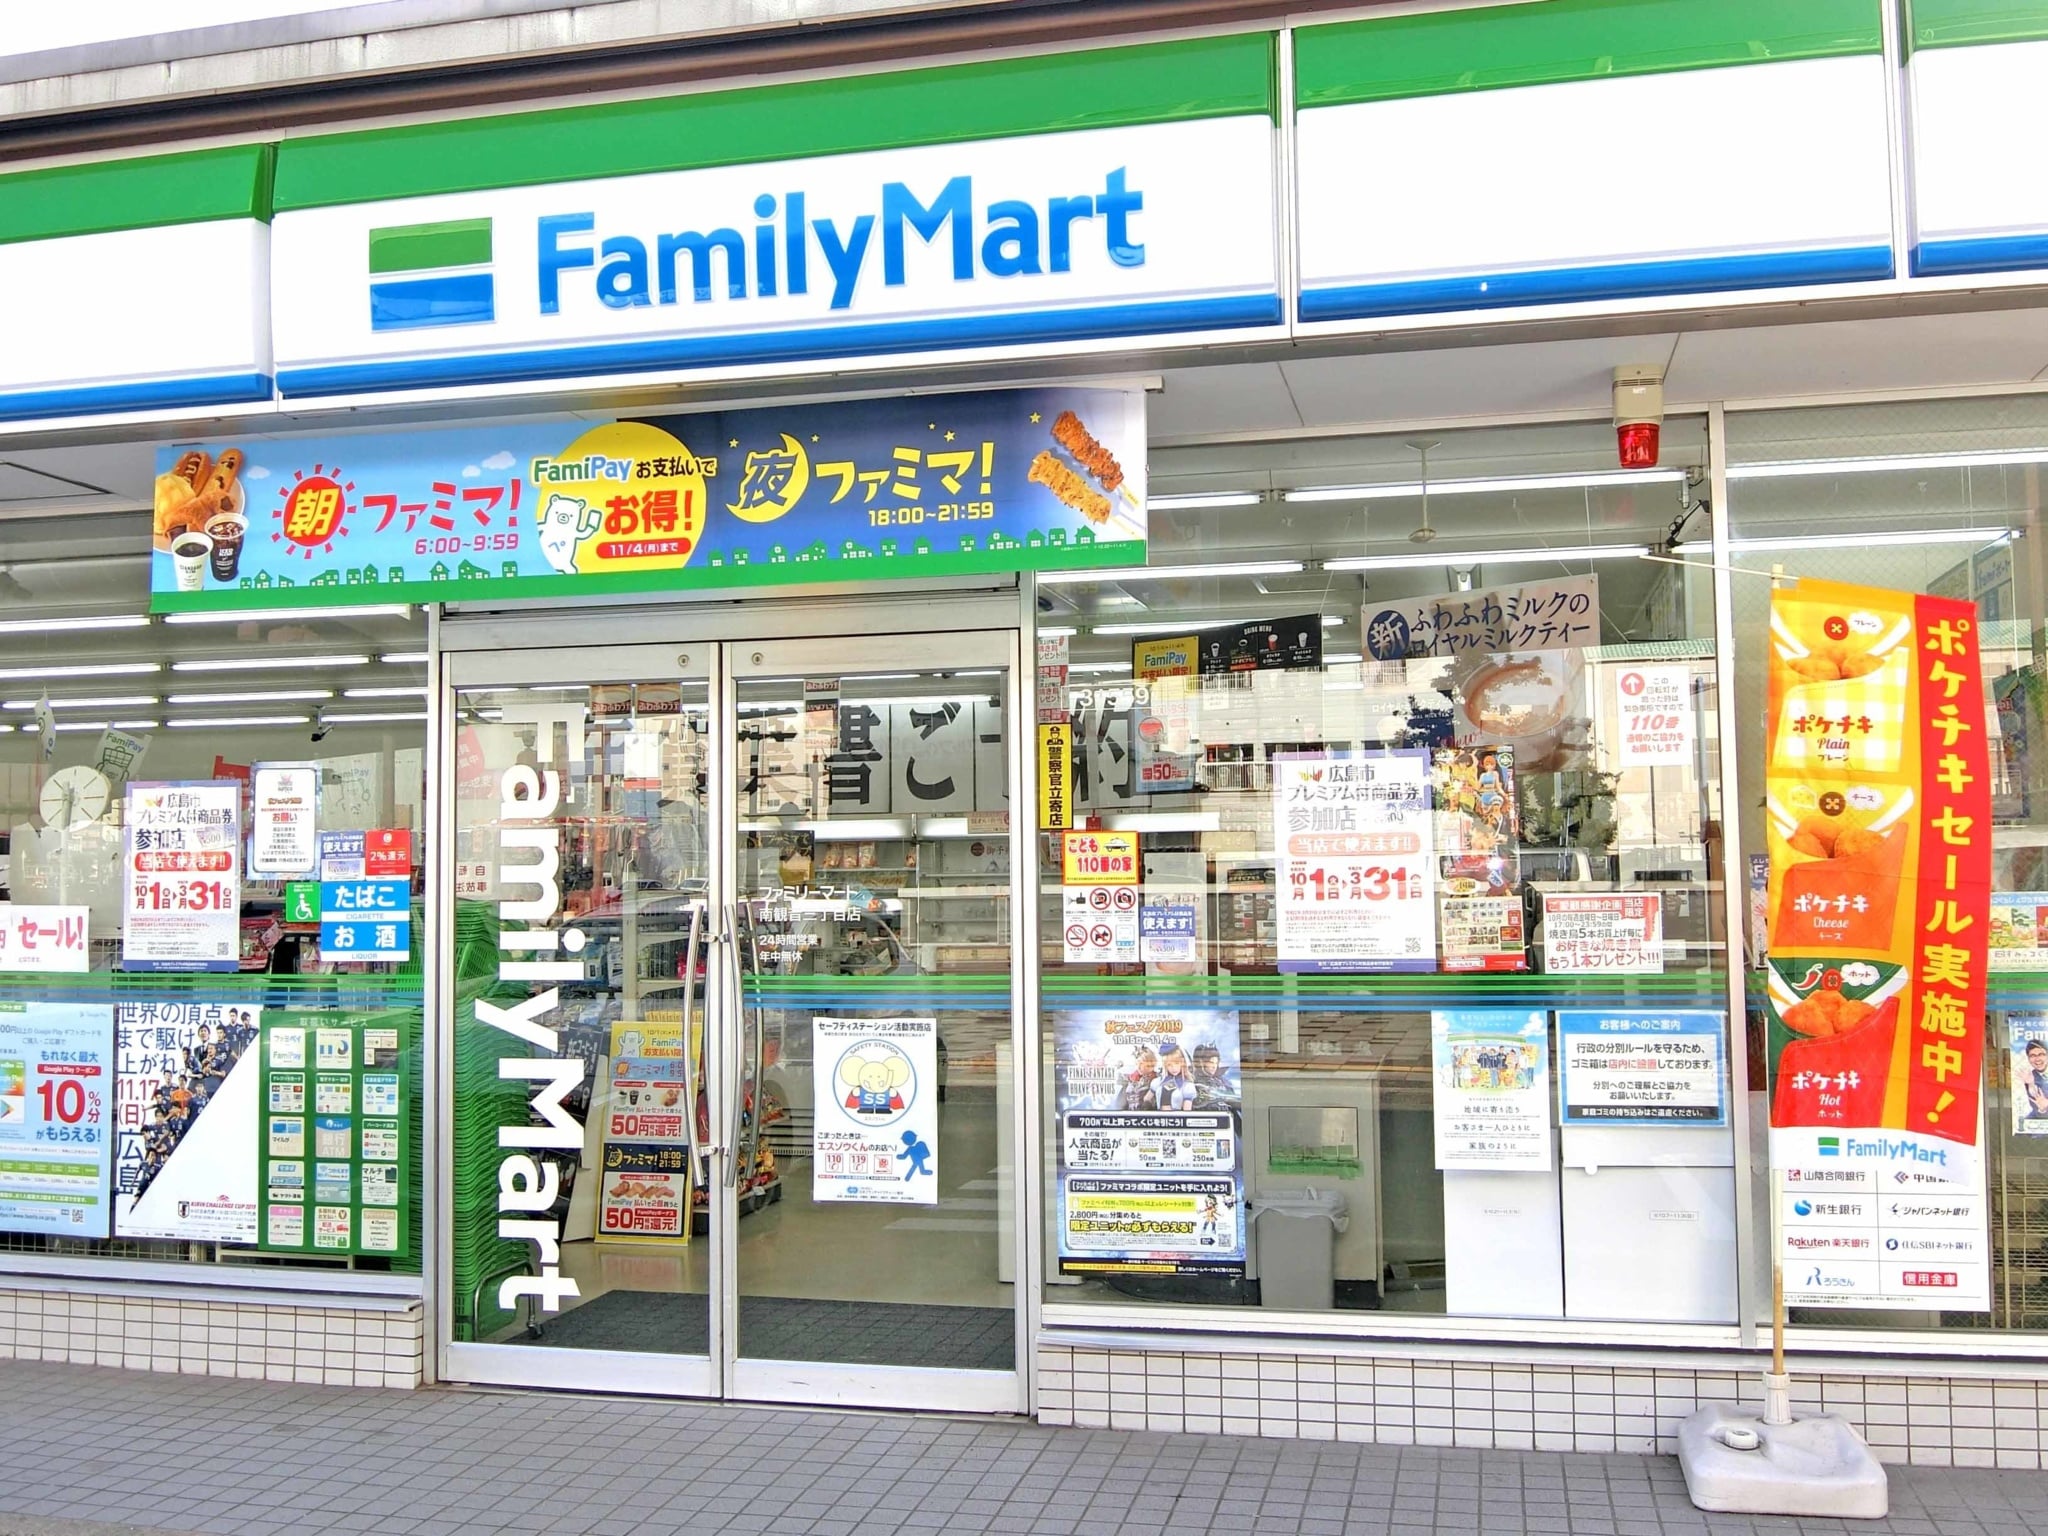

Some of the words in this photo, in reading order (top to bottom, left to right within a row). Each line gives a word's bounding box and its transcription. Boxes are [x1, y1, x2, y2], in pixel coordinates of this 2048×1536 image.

[538, 166, 1145, 314] FamilyMart
[534, 457, 631, 483] FamiPay
[635, 458, 717, 479] お支払いで
[741, 450, 799, 510] 夜
[815, 442, 995, 504] ファミマ!
[287, 488, 339, 537] 朝
[363, 478, 521, 533] ファミマ!
[604, 490, 693, 535] お得!
[869, 502, 994, 526] 18:00~21:59
[610, 541, 679, 556] 11/4(月)まで
[1411, 591, 1590, 632] ふわふわミルクの
[1371, 612, 1405, 660] 新
[1412, 621, 1591, 655] ロイヤルミルクティー
[1144, 651, 1187, 667] FamiPay
[1653, 677, 1669, 685] この
[1646, 686, 1679, 694] 回転灯が
[1631, 714, 1680, 731] 110番
[1792, 714, 1873, 734] ポケチキ
[106, 732, 145, 753] FamiPay
[1631, 744, 1681, 753] お願いします
[1816, 737, 1850, 751] Plain
[1817, 753, 1850, 762] プレーン
[1328, 764, 1376, 783] 広島市
[1048, 746, 1063, 826] 警察官立寄店
[1288, 782, 1421, 801] プレミアム付商品券
[272, 812, 298, 822] お願い
[1288, 805, 1357, 832] 参加店
[322, 840, 363, 853] 使えます!
[1068, 838, 1099, 854] こども
[370, 851, 407, 861] 2%還元
[1077, 856, 1133, 874] 110番の家
[1920, 619, 1974, 1123] ポケチキセール実施中!
[1289, 872, 1307, 886] 10
[1310, 868, 1324, 901] 1
[1364, 866, 1407, 901] 31
[135, 885, 147, 897] 10
[150, 882, 160, 910] 1
[189, 881, 220, 910] 31
[335, 885, 396, 908] たばこ
[758, 886, 858, 902] ファミリーマート
[1793, 892, 1870, 913] ポケチキ
[758, 907, 861, 922] 南観音三丁目店
[1813, 916, 1849, 929] Cheese
[1143, 920, 1193, 930] 使えます!
[18, 916, 83, 951] セール!
[334, 925, 355, 947] お
[375, 925, 396, 947] 酒
[758, 934, 818, 946] 24時間営業
[1555, 939, 1642, 952] お好きな焼き鳥
[351, 952, 378, 960] LIQUOR
[758, 950, 803, 962] 年中無休
[1548, 952, 1660, 969] もう1本プレゼント!!!
[1847, 970, 1872, 980] ホット
[119, 1001, 223, 1026] 世界の頂点
[475, 702, 585, 1312] FamilyMart
[818, 1021, 932, 1032] セーフティステーション活動実施店
[1104, 1019, 1183, 1035] 秋フェスタ2019
[1599, 1019, 1681, 1031] お客様へのご案内
[118, 1027, 197, 1050] まで駆け
[850, 1042, 872, 1055] SAFETY
[874, 1042, 900, 1056] STATION
[1576, 1042, 1706, 1054] 行政の分別ルールを守るため、
[41, 1050, 99, 1063] もれなく最大
[118, 1052, 178, 1075] 上がれ
[1571, 1058, 1714, 1070] ゴミ箱は店内に設置しております。
[44, 1065, 62, 1073] Google
[63, 1066, 75, 1074] Play
[1593, 1080, 1692, 1090] 分別へのご理解とご協力を
[1792, 1070, 1861, 1090] ポケチキ
[118, 1078, 160, 1102] 11.17
[1609, 1091, 1676, 1100] お願いいたします。
[37, 1078, 86, 1124] 10
[863, 1093, 886, 1105] SS
[1818, 1093, 1841, 1107] Hot
[118, 1106, 147, 1126] (日)
[1817, 1110, 1844, 1119] ホット
[611, 1114, 639, 1136] 50
[36, 1126, 101, 1142] がもらえる!
[817, 1141, 898, 1152] エスゾウくんのお店へ!
[1069, 1137, 1122, 1149] 人気商品が
[623, 1153, 658, 1165] ファミマ!
[827, 1154, 841, 1163] 110
[851, 1155, 866, 1164] 119
[1077, 1150, 1114, 1161] 当たる!
[1847, 1138, 1948, 1167] FamilyMart
[659, 1159, 681, 1168] 21:59
[605, 1207, 634, 1229] 50
[1816, 1204, 1862, 1216] 新生銀行
[1903, 1206, 1970, 1217] ジャパンネット銀行
[1788, 1236, 1830, 1248] Rakuten
[1832, 1238, 1870, 1248] 楽天銀行
[1903, 1272, 1957, 1285] 信用金庫
